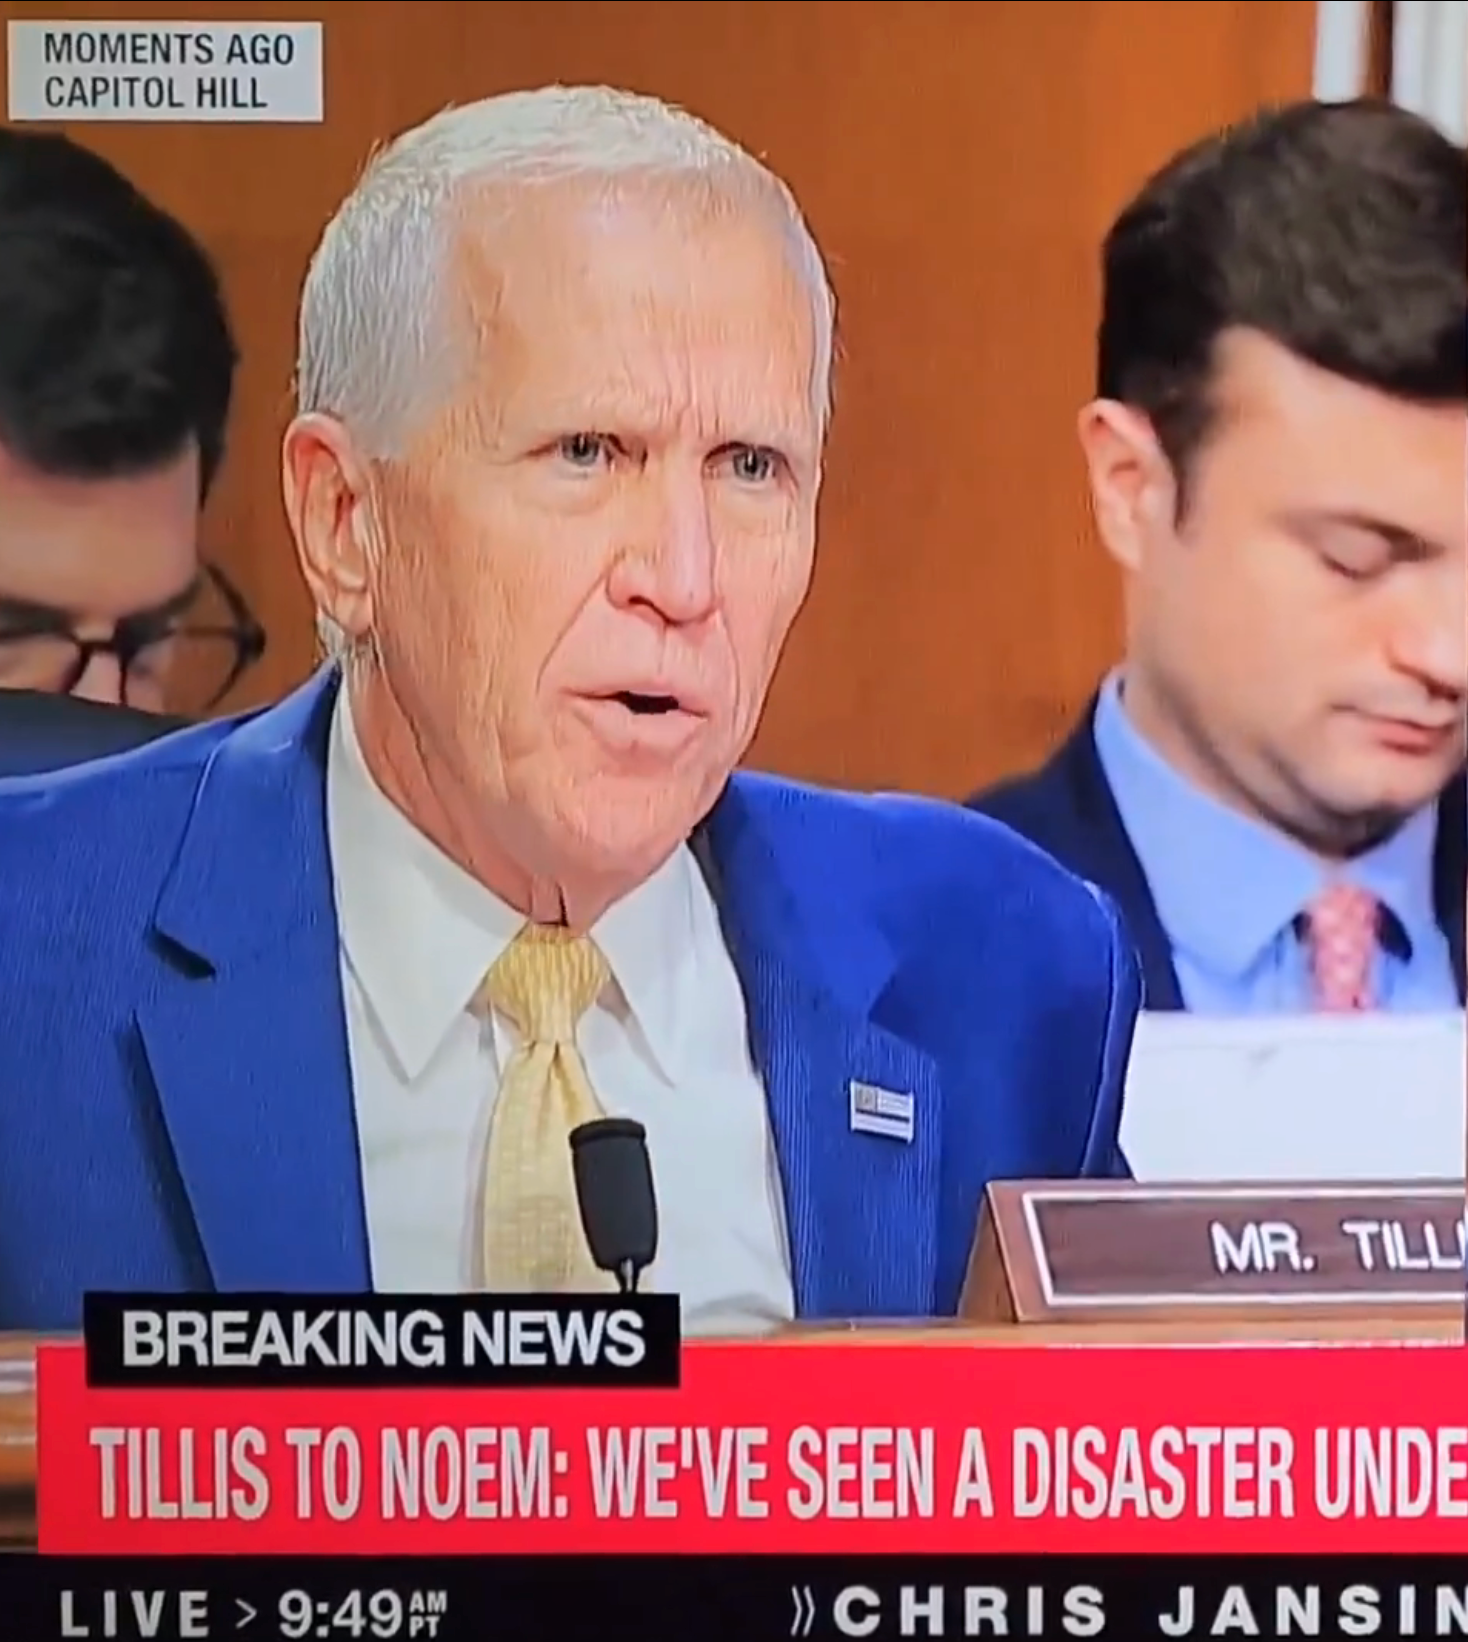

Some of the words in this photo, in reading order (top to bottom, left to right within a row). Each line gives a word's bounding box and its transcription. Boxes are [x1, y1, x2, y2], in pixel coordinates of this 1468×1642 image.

[45, 32, 214, 64] MOMENTS
[226, 34, 294, 65] AGO
[45, 76, 184, 108] CAPITOL
[197, 77, 268, 108] HILL
[1211, 1220, 1315, 1273] MR.
[122, 1310, 445, 1366] BREAKING
[463, 1310, 645, 1366] NEWS
[90, 1426, 269, 1519] TILLIS
[285, 1426, 361, 1519] TO
[381, 1426, 568, 1519] NOEM:
[587, 1427, 768, 1518] WE'VE
[787, 1425, 933, 1519] SEEN
[953, 1427, 993, 1517] A
[1013, 1425, 1294, 1519] DISASTER
[61, 1590, 208, 1637] LIVE
[278, 1589, 402, 1638] 9:49
[410, 1591, 447, 1612] AM
[410, 1615, 440, 1637] PT
[833, 1585, 1106, 1636] CHRIS
